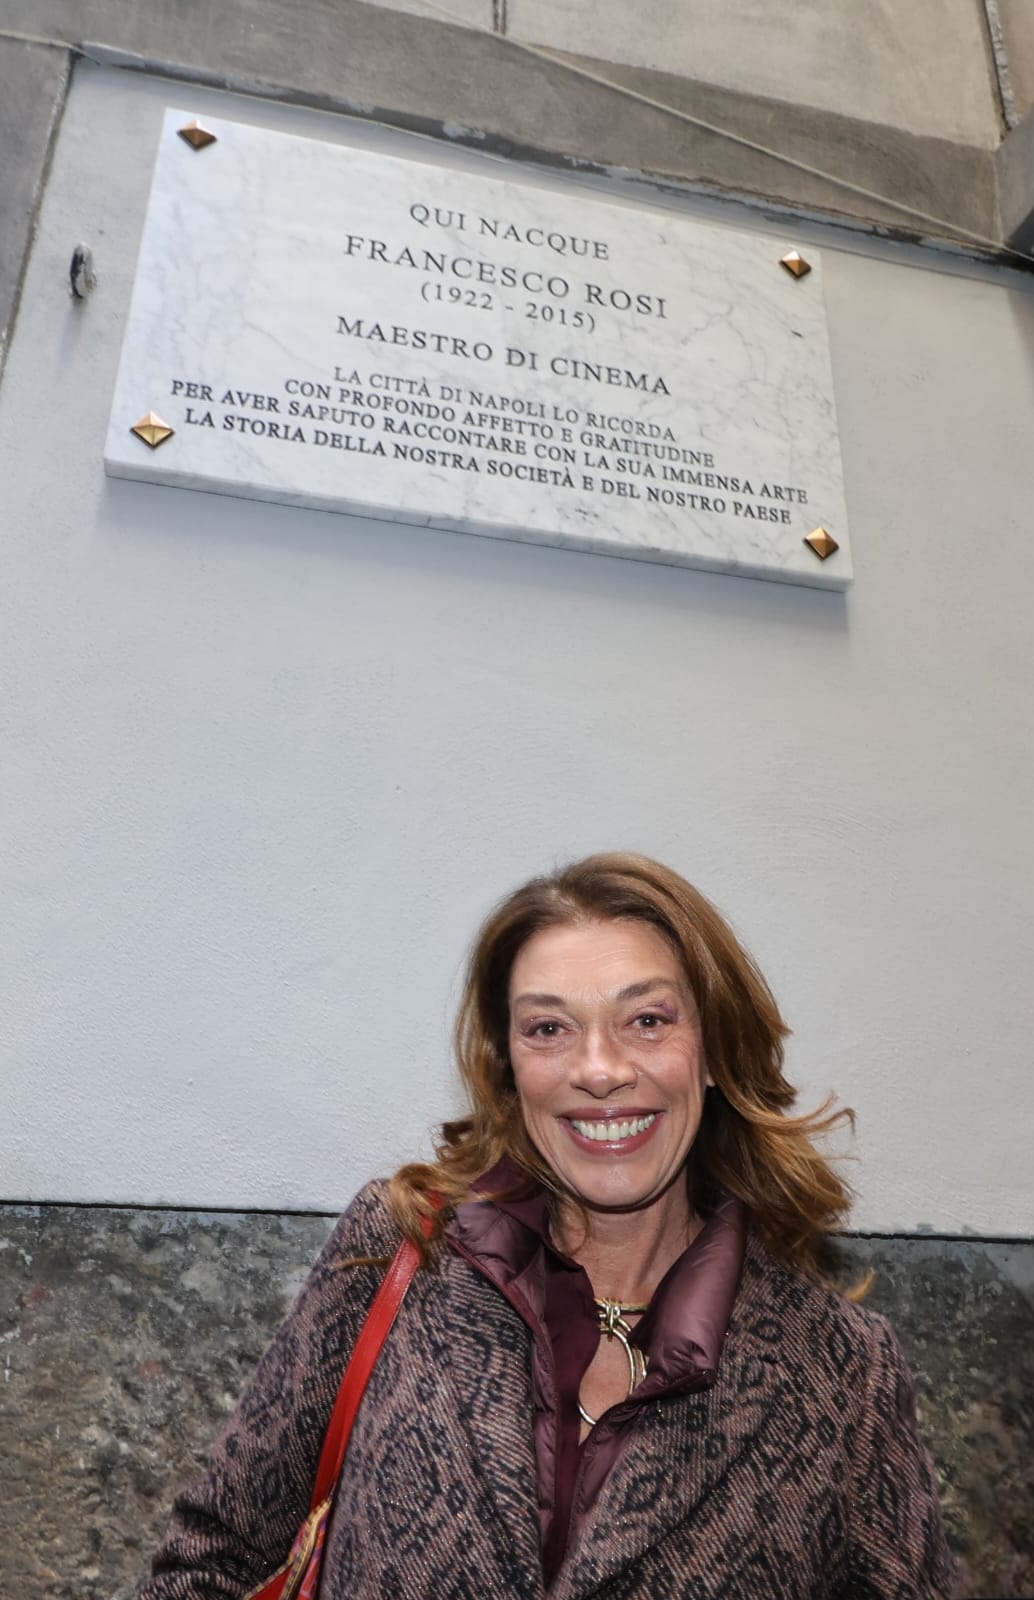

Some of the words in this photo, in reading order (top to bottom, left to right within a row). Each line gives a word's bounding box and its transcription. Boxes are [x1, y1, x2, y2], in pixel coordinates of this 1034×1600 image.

[409, 203, 466, 231] QUI
[480, 218, 610, 261] NACQUE
[345, 234, 569, 298] FRANCESCO
[584, 282, 668, 319] ROSI
[421, 282, 494, 311] (1922
[526, 302, 596, 334] 2015)
[336, 316, 493, 361] MAESTRO
[505, 348, 539, 370] DI
[550, 357, 672, 396] CINEMA
[171, 380, 214, 401] PER
[221, 389, 280, 413] AVER
[288, 401, 375, 429] SAPUTO
[383, 418, 527, 455] RACCONTARE
[535, 444, 577, 464] CON
[584, 452, 610, 470] LA
[616, 458, 657, 478] SUA
[662, 466, 755, 495] IMMENSA
[760, 484, 808, 504] ARTE
[285, 379, 332, 400] CON
[339, 389, 456, 422] PROFONDO
[462, 412, 554, 439] AFFETTO
[562, 428, 573, 442] E
[580, 432, 715, 468] GRATITUDINE
[334, 366, 362, 384] LA
[370, 375, 431, 397] CITTÀ
[440, 386, 462, 403] DI
[469, 392, 545, 418] NAPOLI
[553, 407, 579, 423] LO
[586, 413, 677, 441] RICORDA
[184, 408, 215, 427] LA
[223, 416, 306, 442] STORIA
[313, 430, 387, 457] DELLA
[393, 444, 481, 473] NOSTRA
[487, 459, 575, 488] SOCIETÀ
[582, 476, 594, 491] E
[602, 480, 640, 499] DEL
[647, 487, 726, 513] NOSTRO
[733, 501, 792, 525] PAESE
